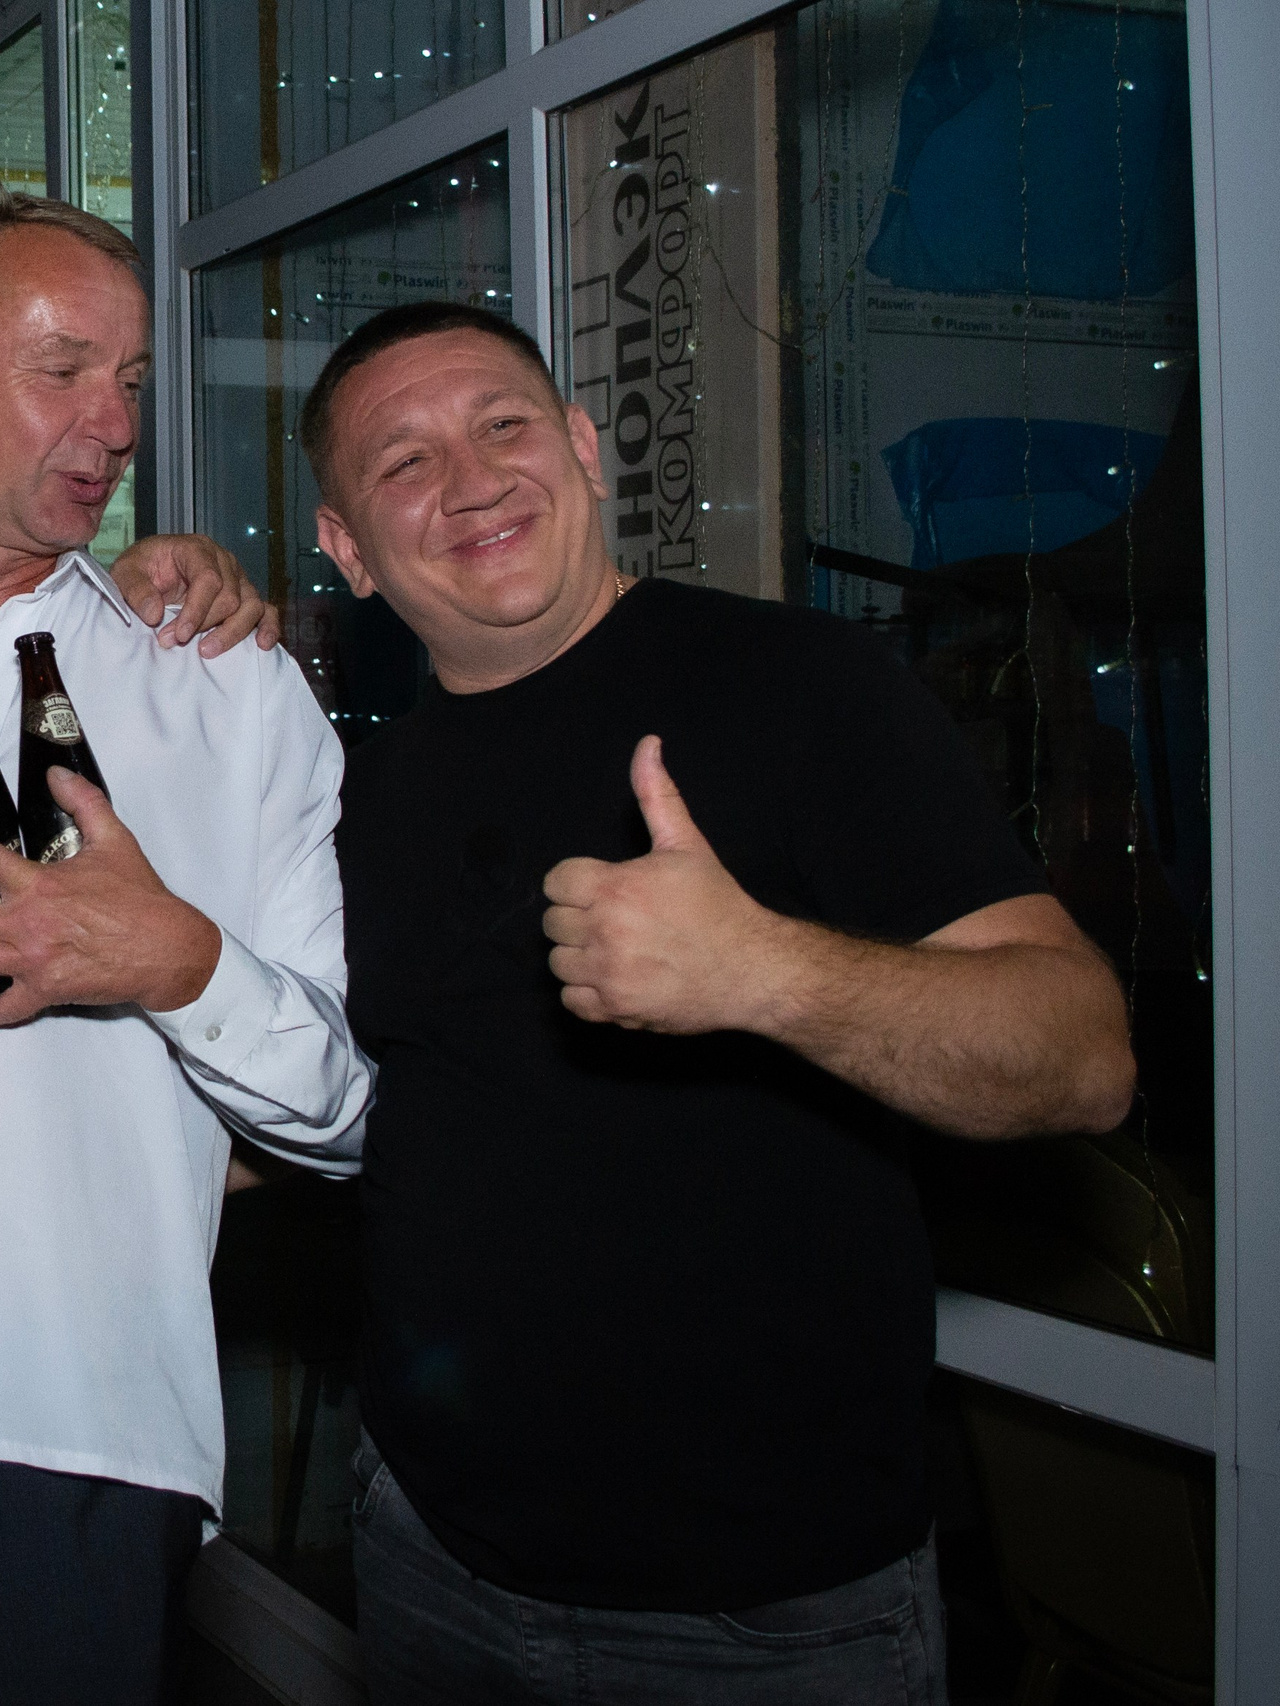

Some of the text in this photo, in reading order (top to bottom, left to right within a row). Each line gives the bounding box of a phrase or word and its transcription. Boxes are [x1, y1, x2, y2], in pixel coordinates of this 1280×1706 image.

[829, 187, 840, 242] Plaswin
[394, 273, 449, 288] Plaswin
[867, 296, 915, 311] Plaswin
[654, 103, 695, 570] КОМФОРТ
[946, 318, 993, 332] Plaswin
[834, 378, 844, 434] Plaswin
